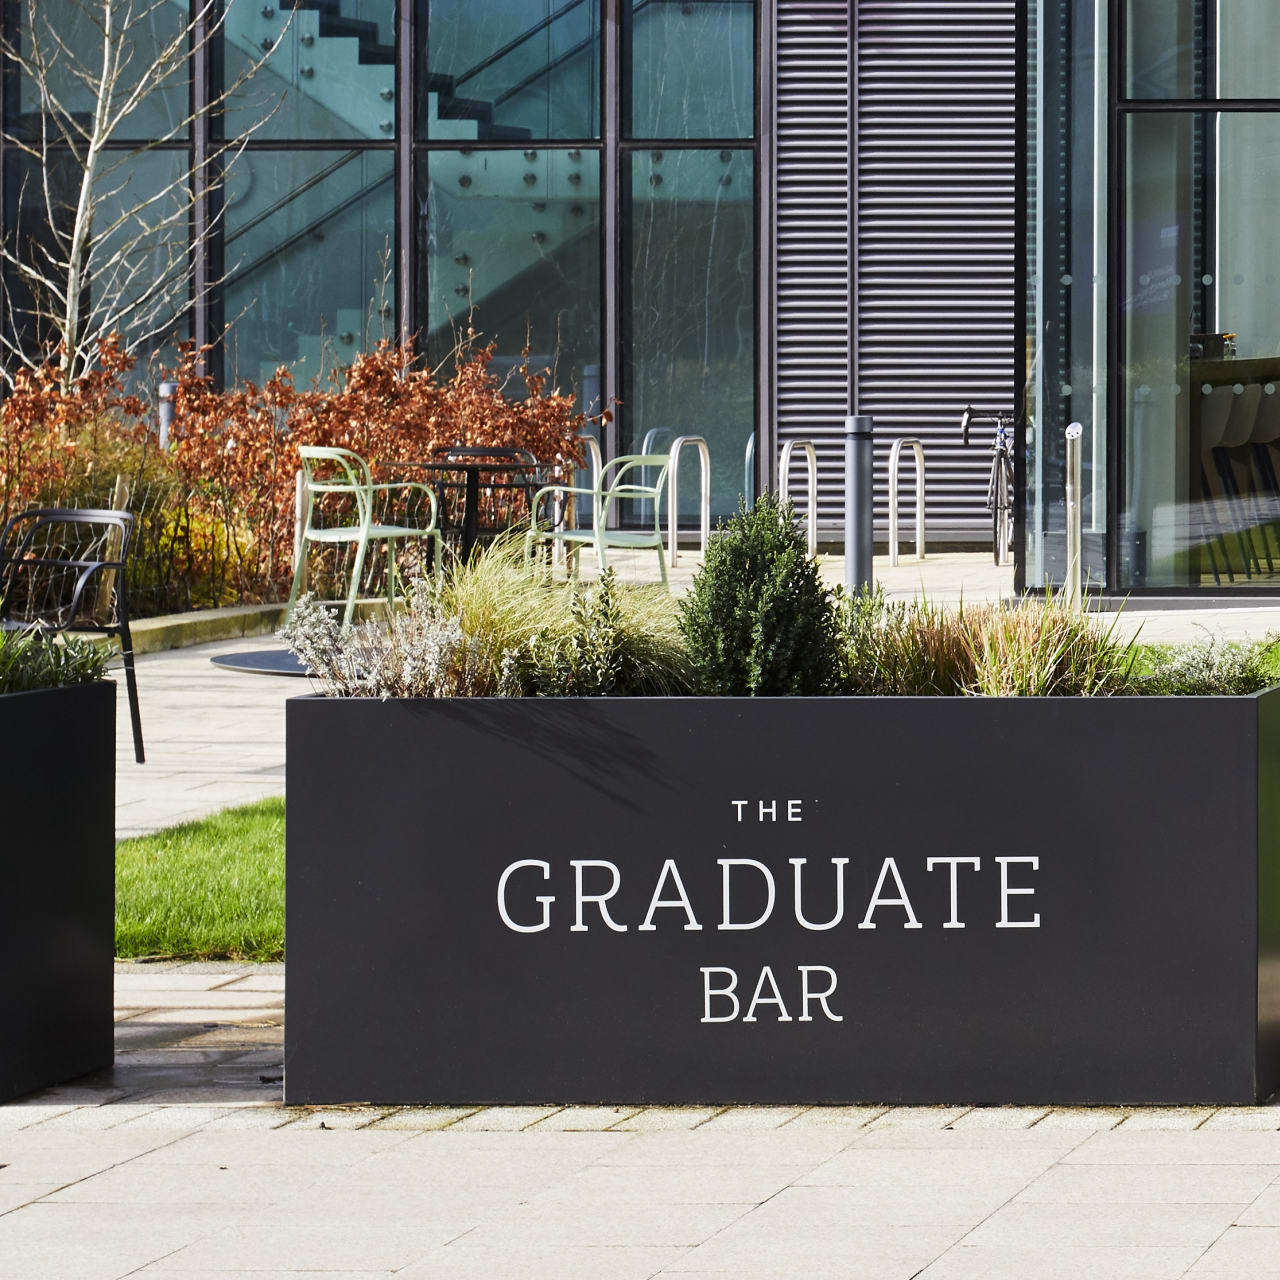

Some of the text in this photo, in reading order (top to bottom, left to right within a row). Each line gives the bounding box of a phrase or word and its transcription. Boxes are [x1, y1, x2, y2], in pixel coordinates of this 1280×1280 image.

[732, 800, 803, 822] THE
[497, 856, 1041, 933] GRADUATE
[700, 965, 844, 1023] BAR
